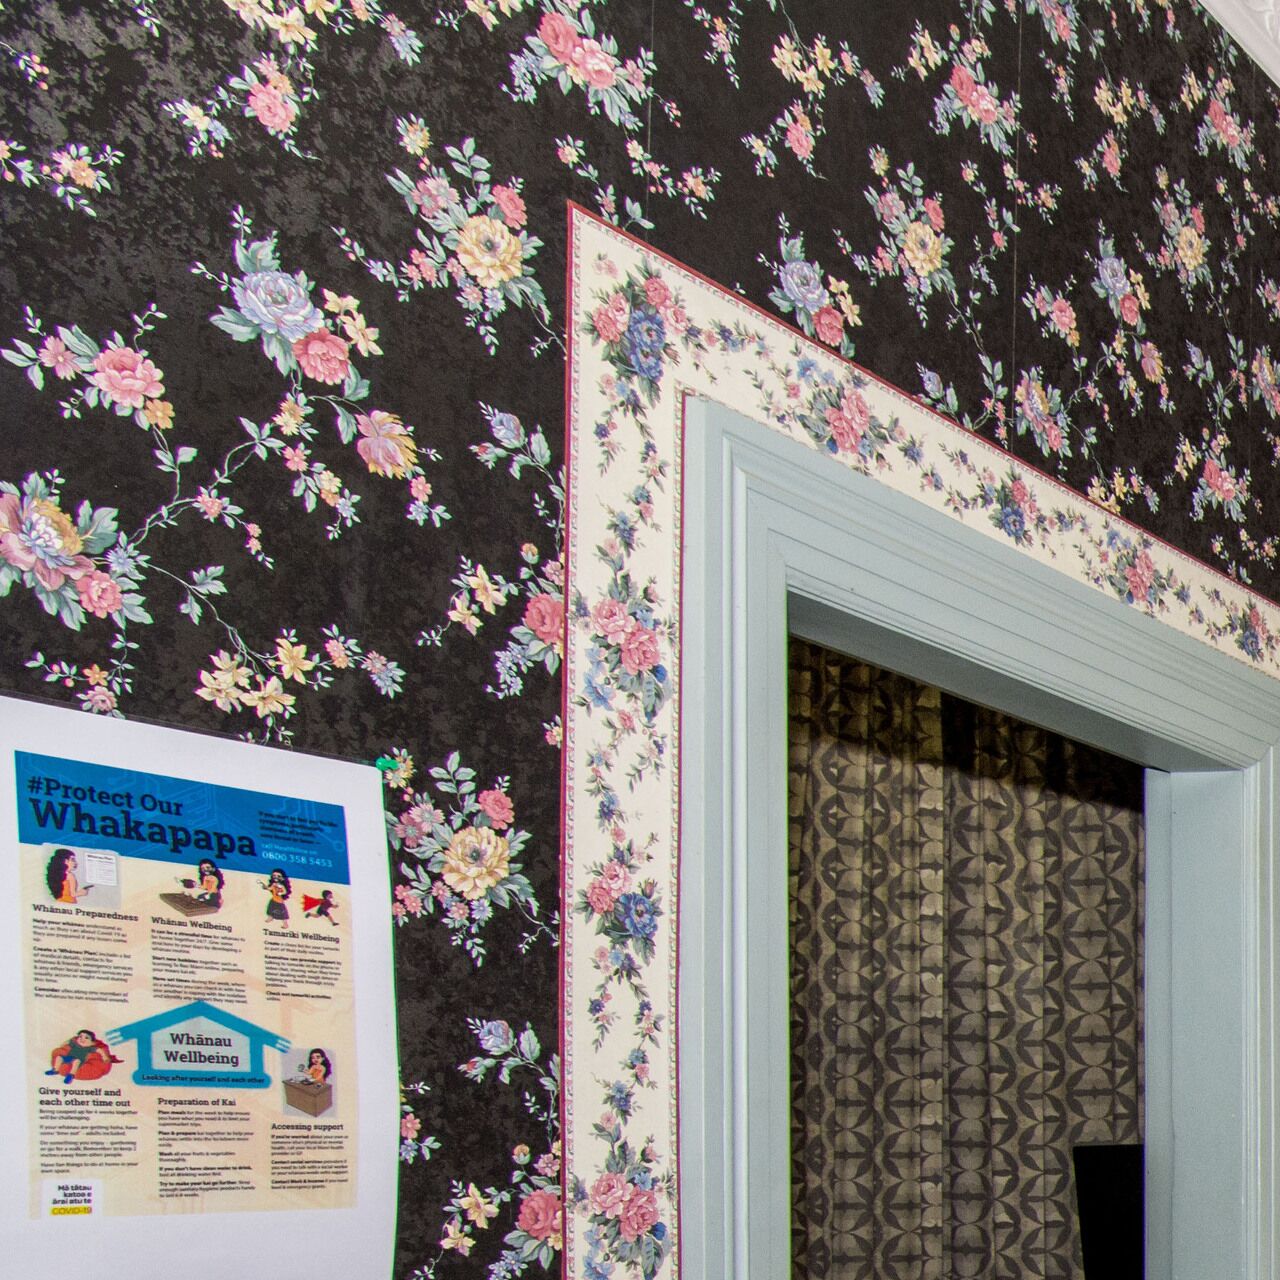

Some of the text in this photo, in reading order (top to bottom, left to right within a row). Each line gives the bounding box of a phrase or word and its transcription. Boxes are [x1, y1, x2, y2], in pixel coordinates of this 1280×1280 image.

[27, 776, 183, 816] #Protect Our
[28, 798, 257, 859] Whakapapa
[262, 851, 333, 867] 0800 358 5453
[75, 908, 139, 921] Preparedness
[189, 920, 232, 933] Wellbeing
[263, 928, 340, 944] Tamariki Wellbeing
[170, 1033, 232, 1047] Whānau
[164, 1050, 239, 1067] Wellbeing
[39, 1087, 121, 1098] Give yourself and
[39, 1098, 131, 1107] each other time out
[158, 1098, 236, 1107] Preparation of Kai
[271, 1123, 344, 1132] Accessing support
[51, 1206, 92, 1216] COVID-19
